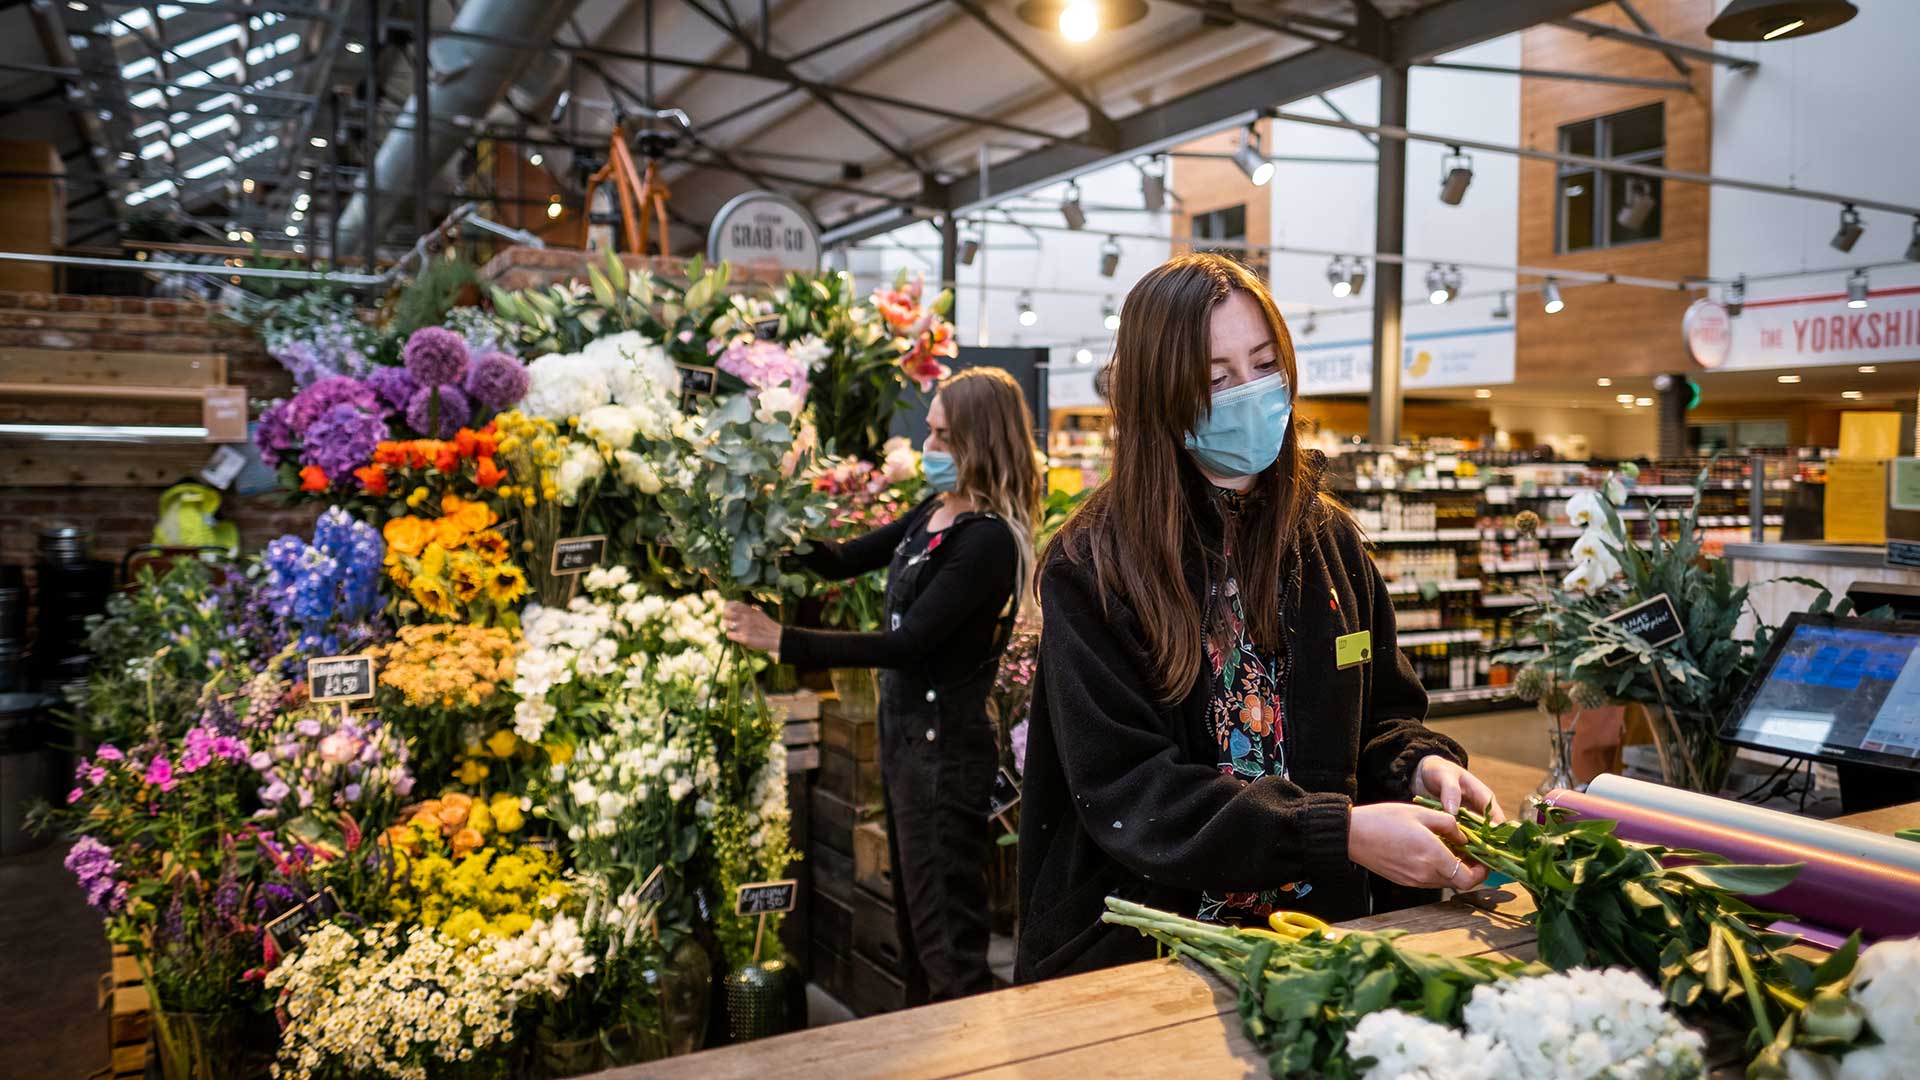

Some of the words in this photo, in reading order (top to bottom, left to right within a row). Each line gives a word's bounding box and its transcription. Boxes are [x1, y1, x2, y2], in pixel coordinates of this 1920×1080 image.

[732, 225, 772, 250] GRAB
[784, 228, 803, 251] GO
[1760, 328, 1784, 350] THE
